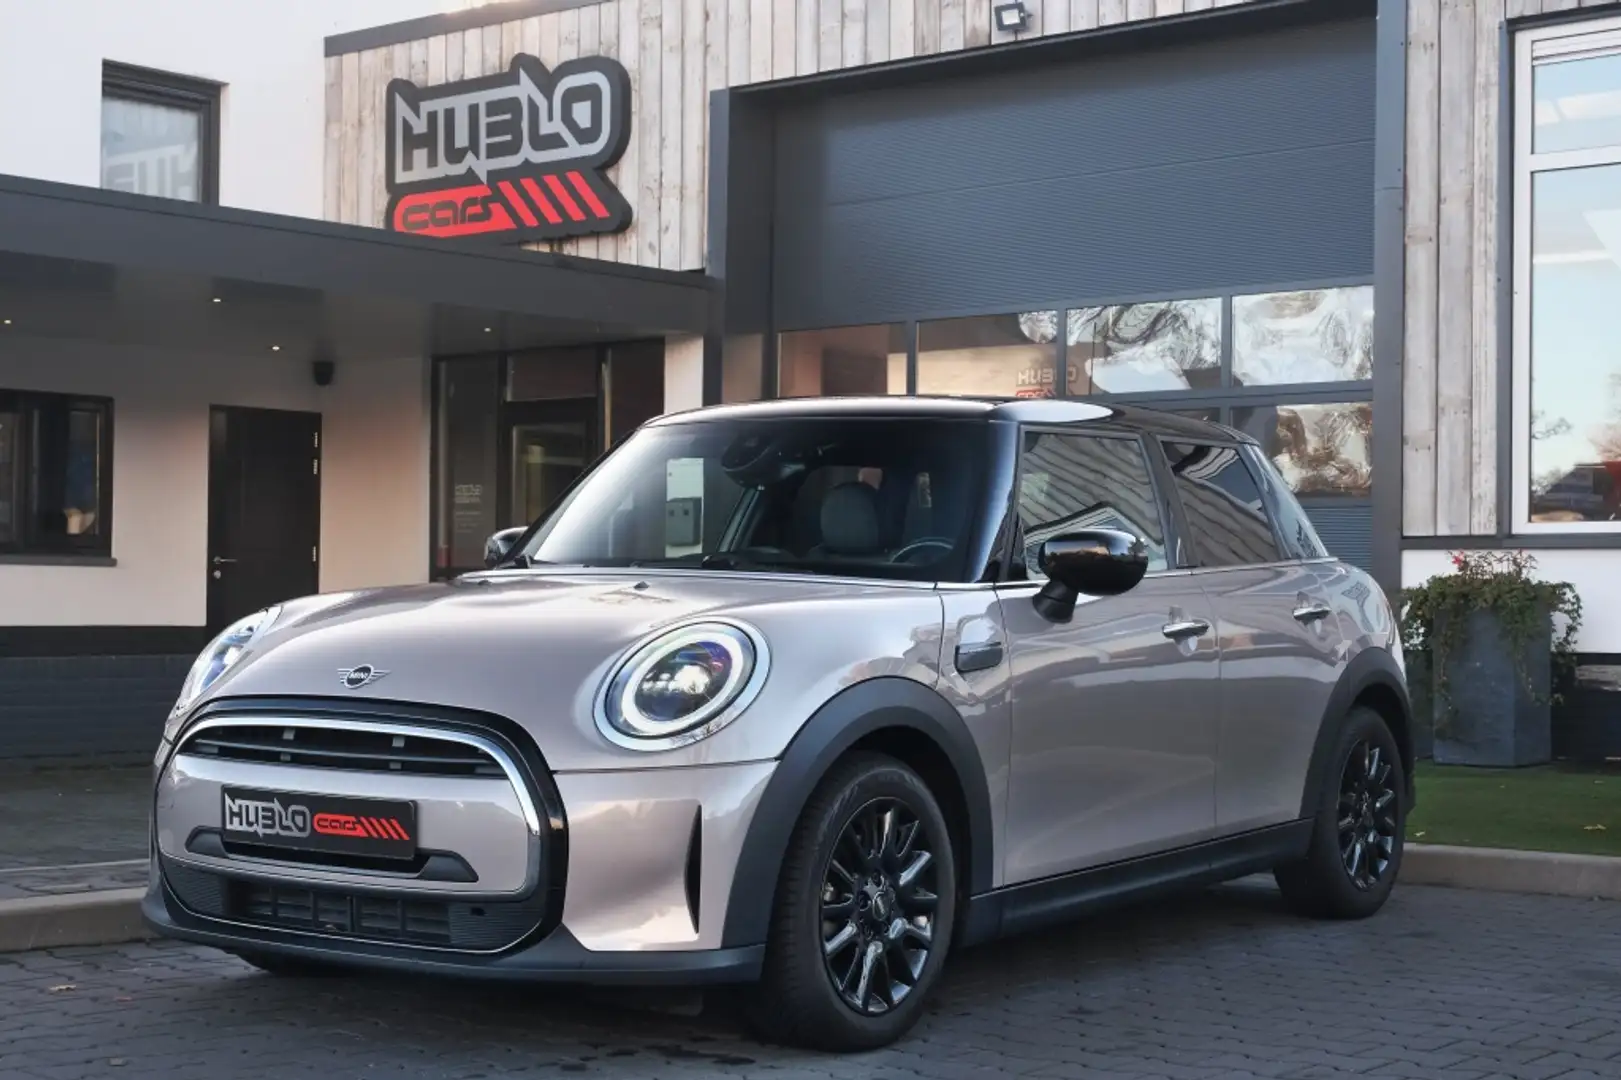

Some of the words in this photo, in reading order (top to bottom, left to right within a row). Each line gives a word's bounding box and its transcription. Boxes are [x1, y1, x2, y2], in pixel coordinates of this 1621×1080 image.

[396, 70, 610, 182] HUBLO
[401, 192, 495, 232] cars
[1018, 365, 1077, 384] HUBO
[349, 671, 369, 679] MINI
[225, 793, 310, 837] HUBLO
